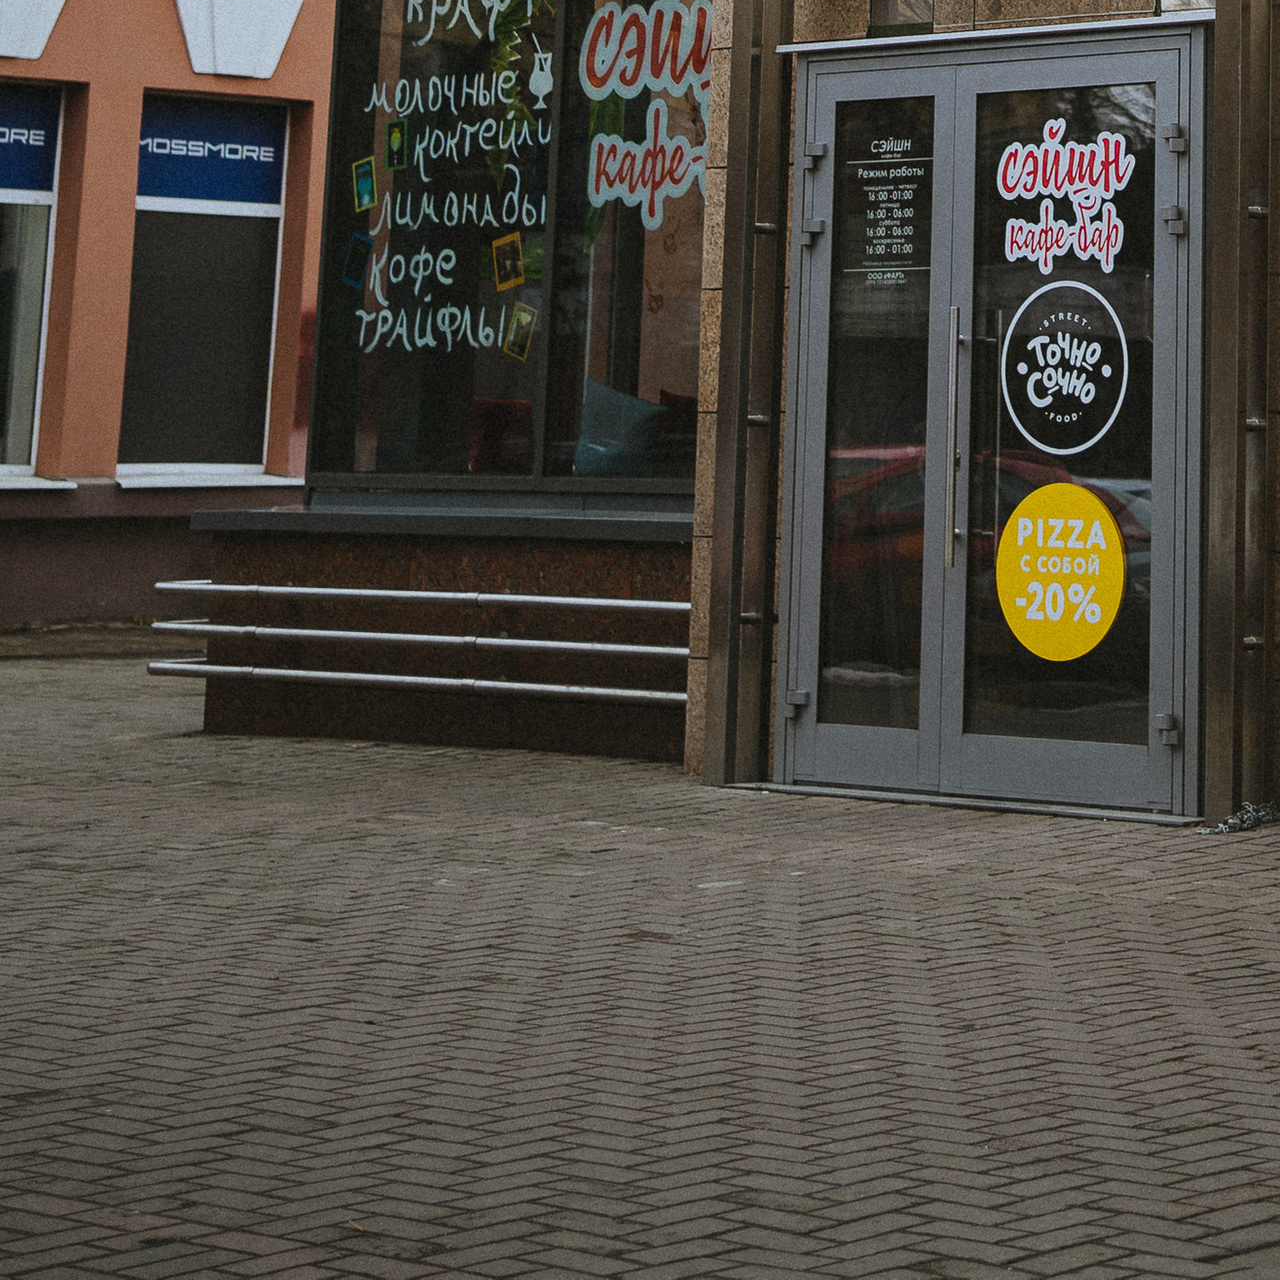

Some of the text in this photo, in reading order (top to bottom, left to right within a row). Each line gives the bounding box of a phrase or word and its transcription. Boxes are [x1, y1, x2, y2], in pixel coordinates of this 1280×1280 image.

[0, 127, 45, 146] ORE
[871, 137, 911, 153] СЭЙШН
[858, 166, 925, 179] Режим работы
[867, 209, 887, 219] 16:00
[893, 208, 914, 218] 06:00
[866, 227, 886, 237] 16:00
[892, 226, 914, 236] 06:00
[866, 245, 886, 255] 16:00
[892, 244, 913, 254] 01:00
[867, 272, 882, 280] ООО
[1043, 312, 1088, 327] STREET
[1049, 412, 1078, 422] FOOD
[1017, 517, 1107, 550] PIZZA
[1036, 553, 1100, 575] СОБОЙ
[1015, 581, 1102, 624] -20%
